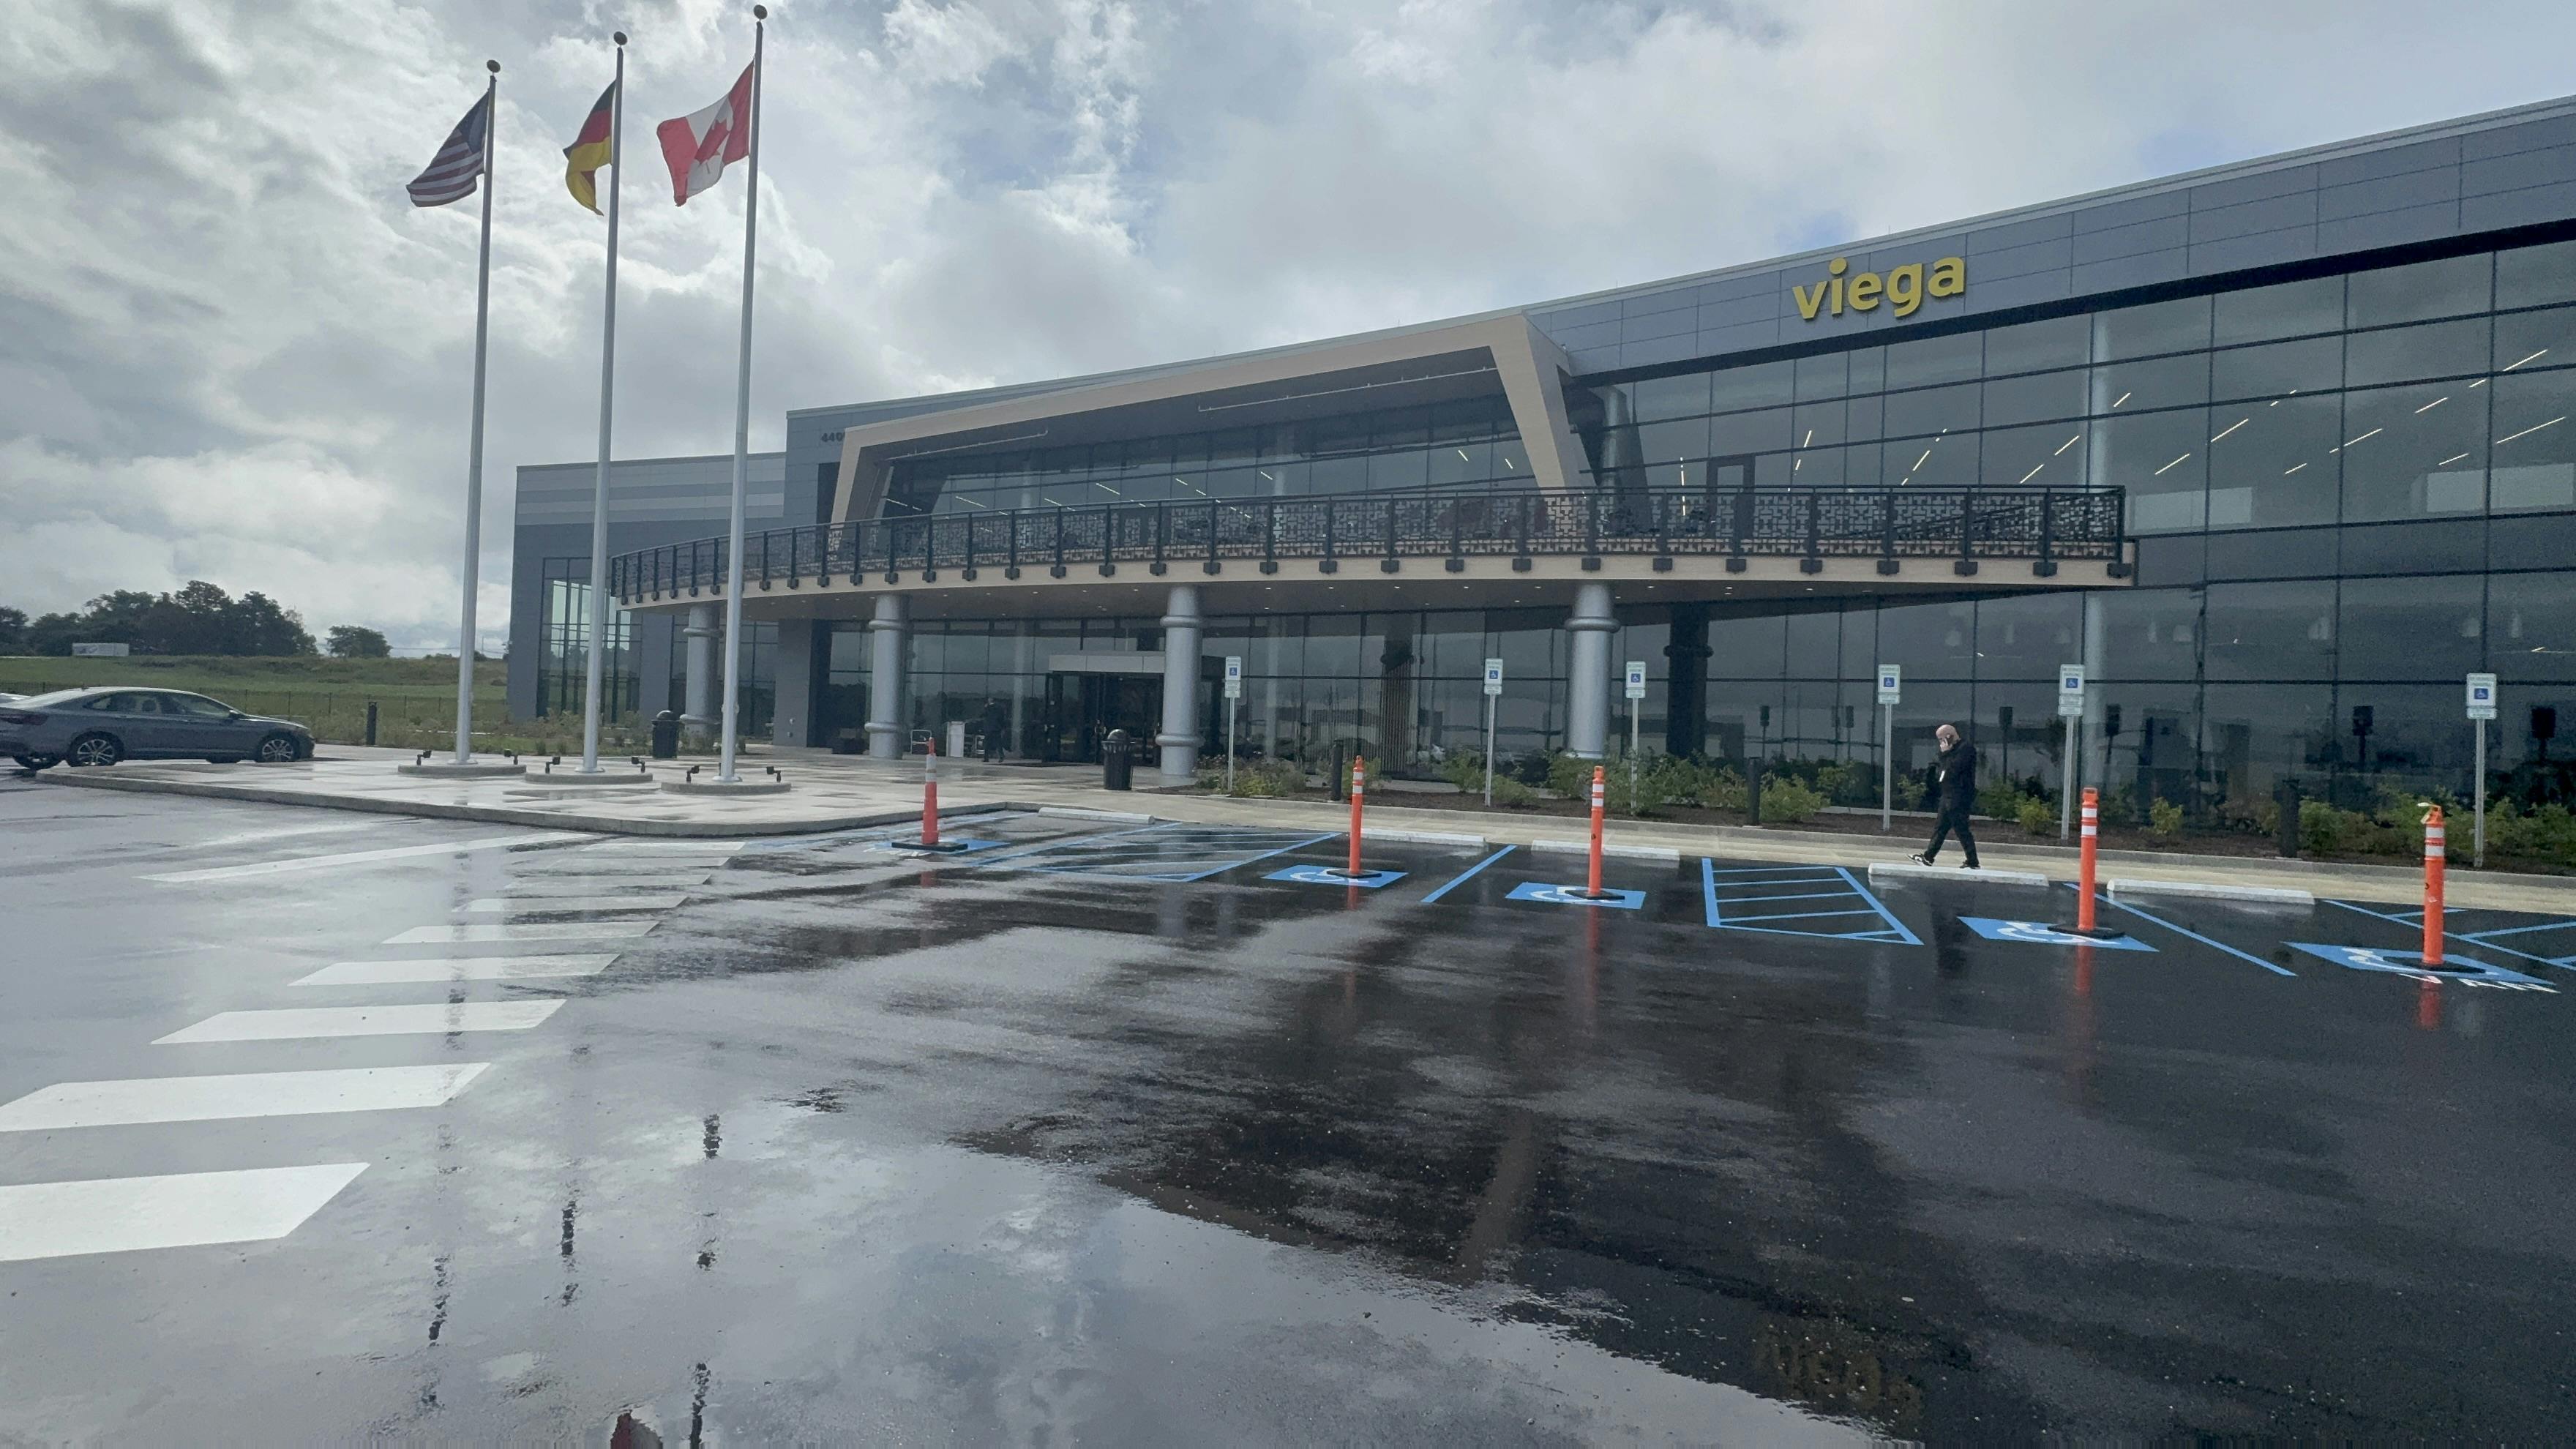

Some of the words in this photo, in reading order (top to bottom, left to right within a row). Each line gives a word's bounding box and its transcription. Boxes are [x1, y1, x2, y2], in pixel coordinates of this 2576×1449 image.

[1791, 257, 1965, 319] viega
[820, 431, 845, 442] 440
[2397, 973, 2561, 993] VAN
